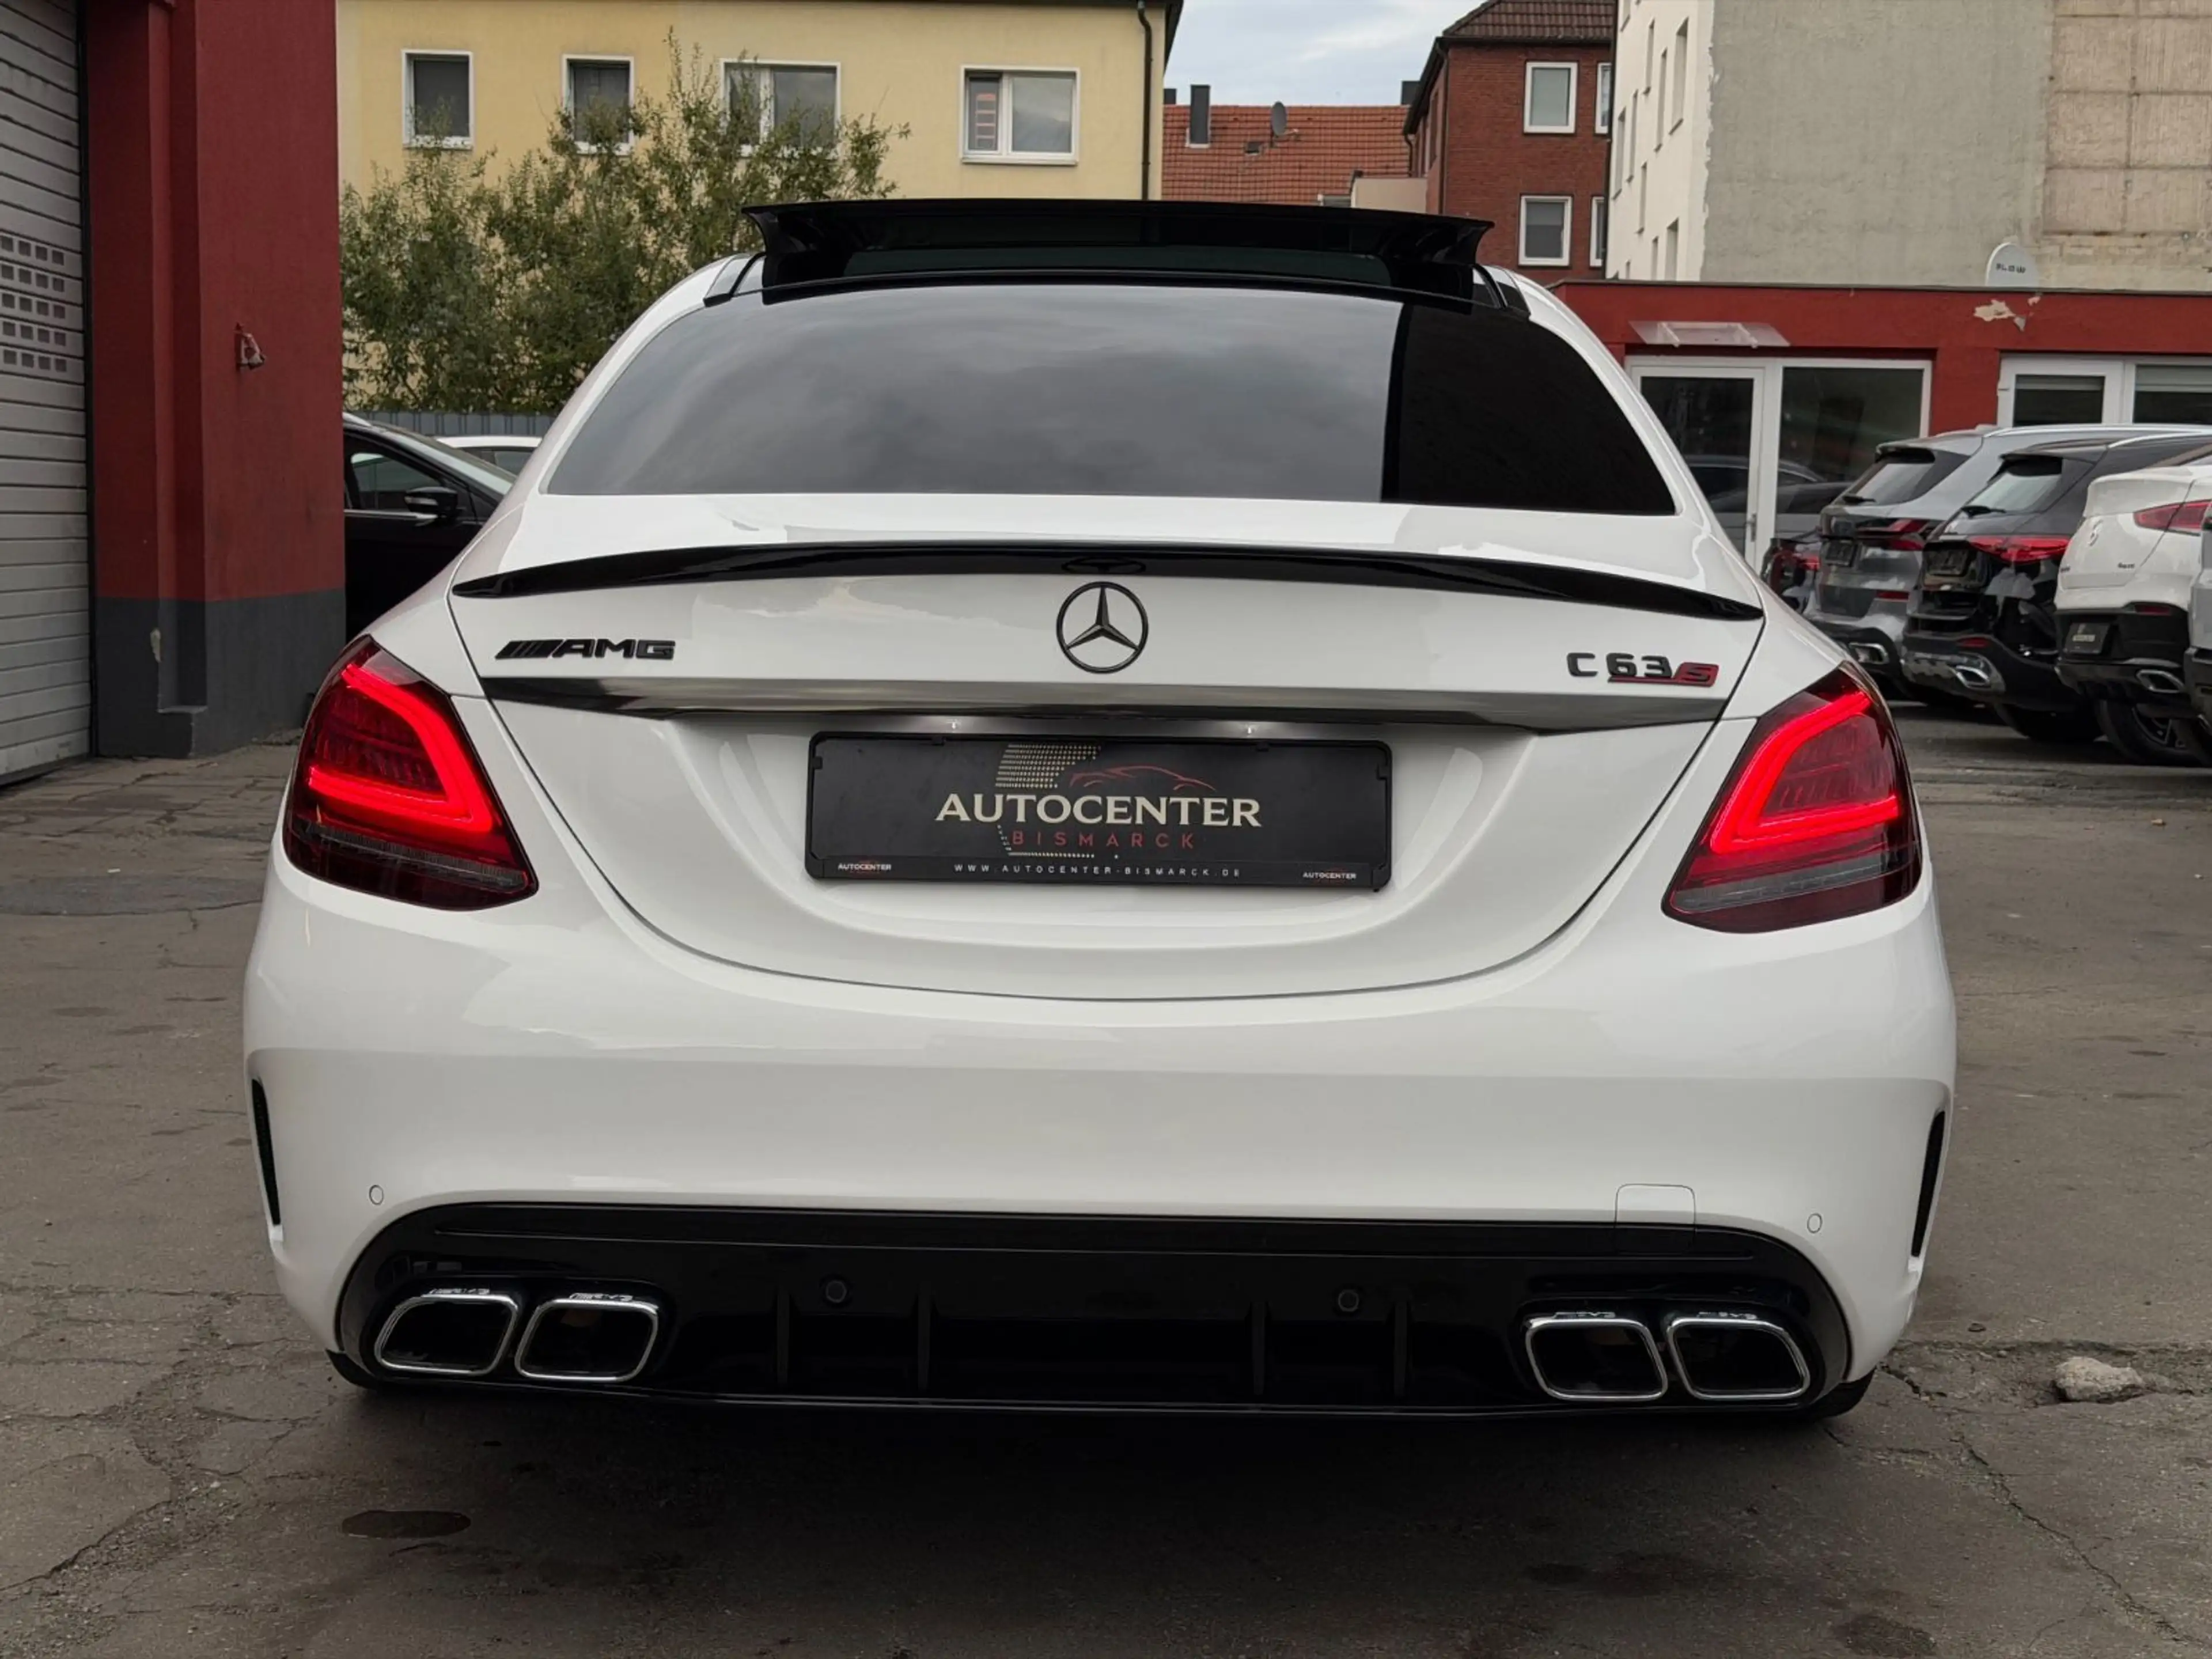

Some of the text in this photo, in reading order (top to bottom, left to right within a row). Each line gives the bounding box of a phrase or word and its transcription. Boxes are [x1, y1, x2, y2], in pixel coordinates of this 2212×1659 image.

[551, 639, 676, 660] AMG
[935, 793, 1262, 827] AUTOCENTER
[1012, 831, 1194, 849] BISMARCK
[1302, 872, 1357, 880] AUTOCENTER
